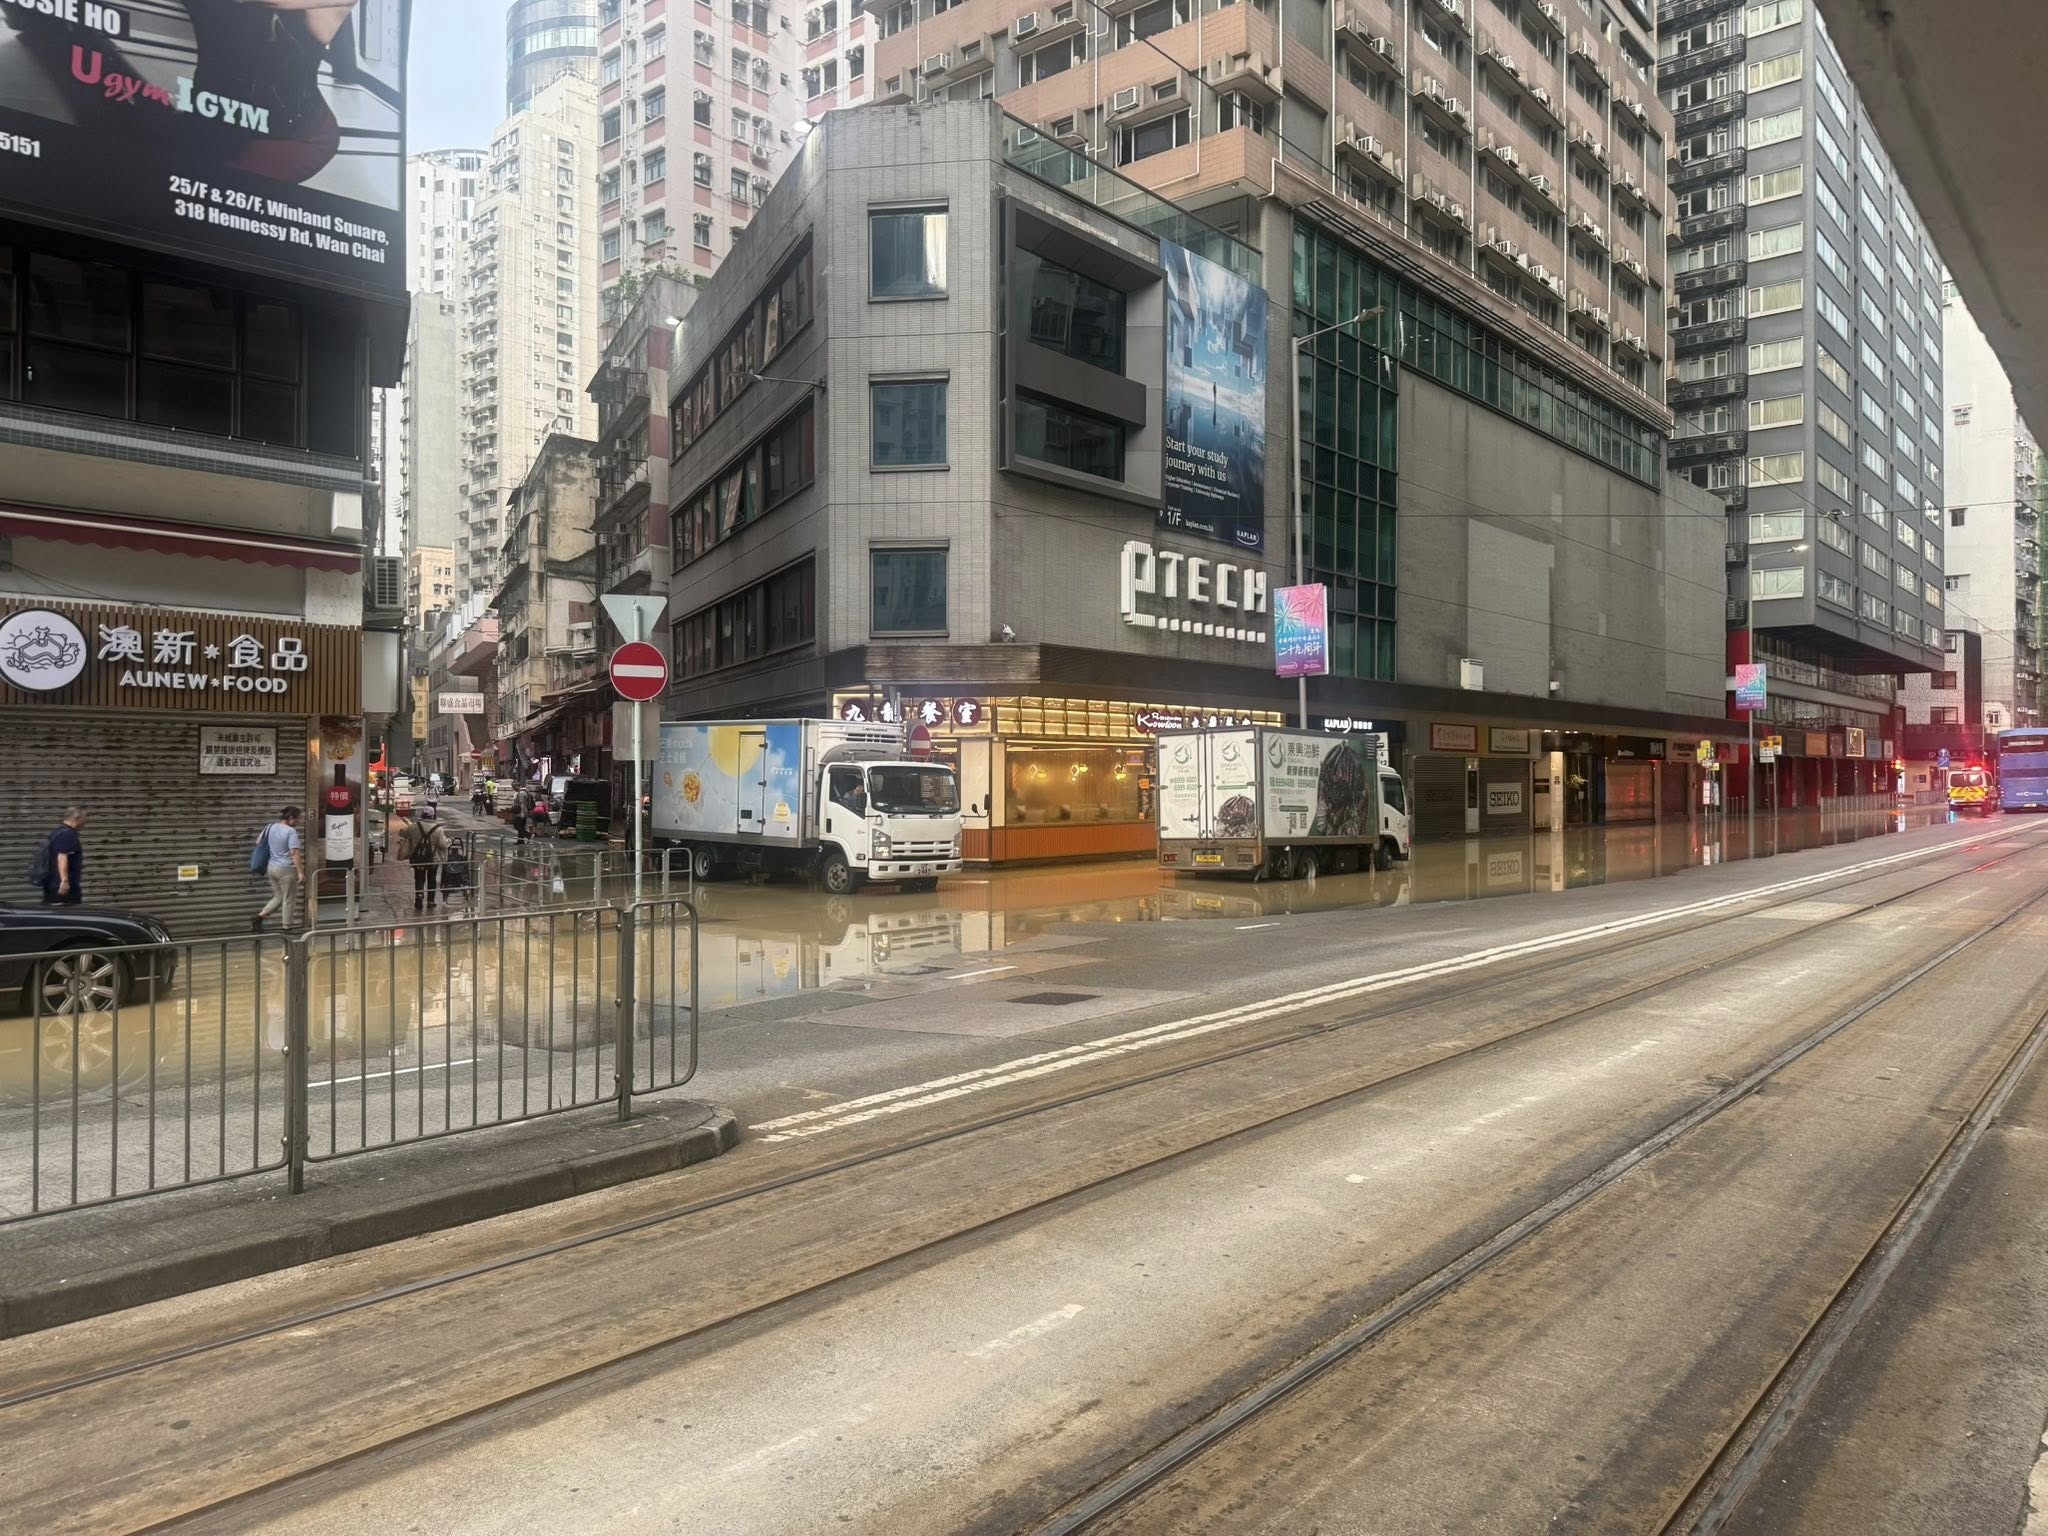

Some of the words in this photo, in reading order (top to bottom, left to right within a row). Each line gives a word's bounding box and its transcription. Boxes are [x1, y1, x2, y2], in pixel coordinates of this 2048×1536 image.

[84, 2, 120, 35] HO
[0, 131, 40, 158] 5151
[169, 175, 208, 199] 25/F
[210, 188, 223, 203] &
[225, 189, 264, 215] 26/F,
[267, 199, 331, 230] Winland
[334, 217, 389, 245] Square,
[175, 199, 205, 221] 318
[208, 206, 286, 241] Hennessy
[290, 227, 313, 248] Rd,
[315, 233, 349, 255] Wan
[352, 242, 385, 264] Chai
[1165, 436, 1186, 452] Start
[1187, 444, 1205, 458] your
[1207, 451, 1229, 468] study
[1165, 453, 1196, 476] journey
[1197, 463, 1215, 479] with
[1217, 471, 1227, 482] us
[1167, 510, 1182, 526] 1/F
[1236, 529, 1257, 542] KAPLAN
[227, 634, 308, 672] 食品
[119, 670, 208, 691] AUNEW
[223, 675, 288, 693] FOOD
[1136, 714, 1182, 729] Kowloon
[330, 791, 349, 801] 特價
[1489, 791, 1520, 807] SEIKO
